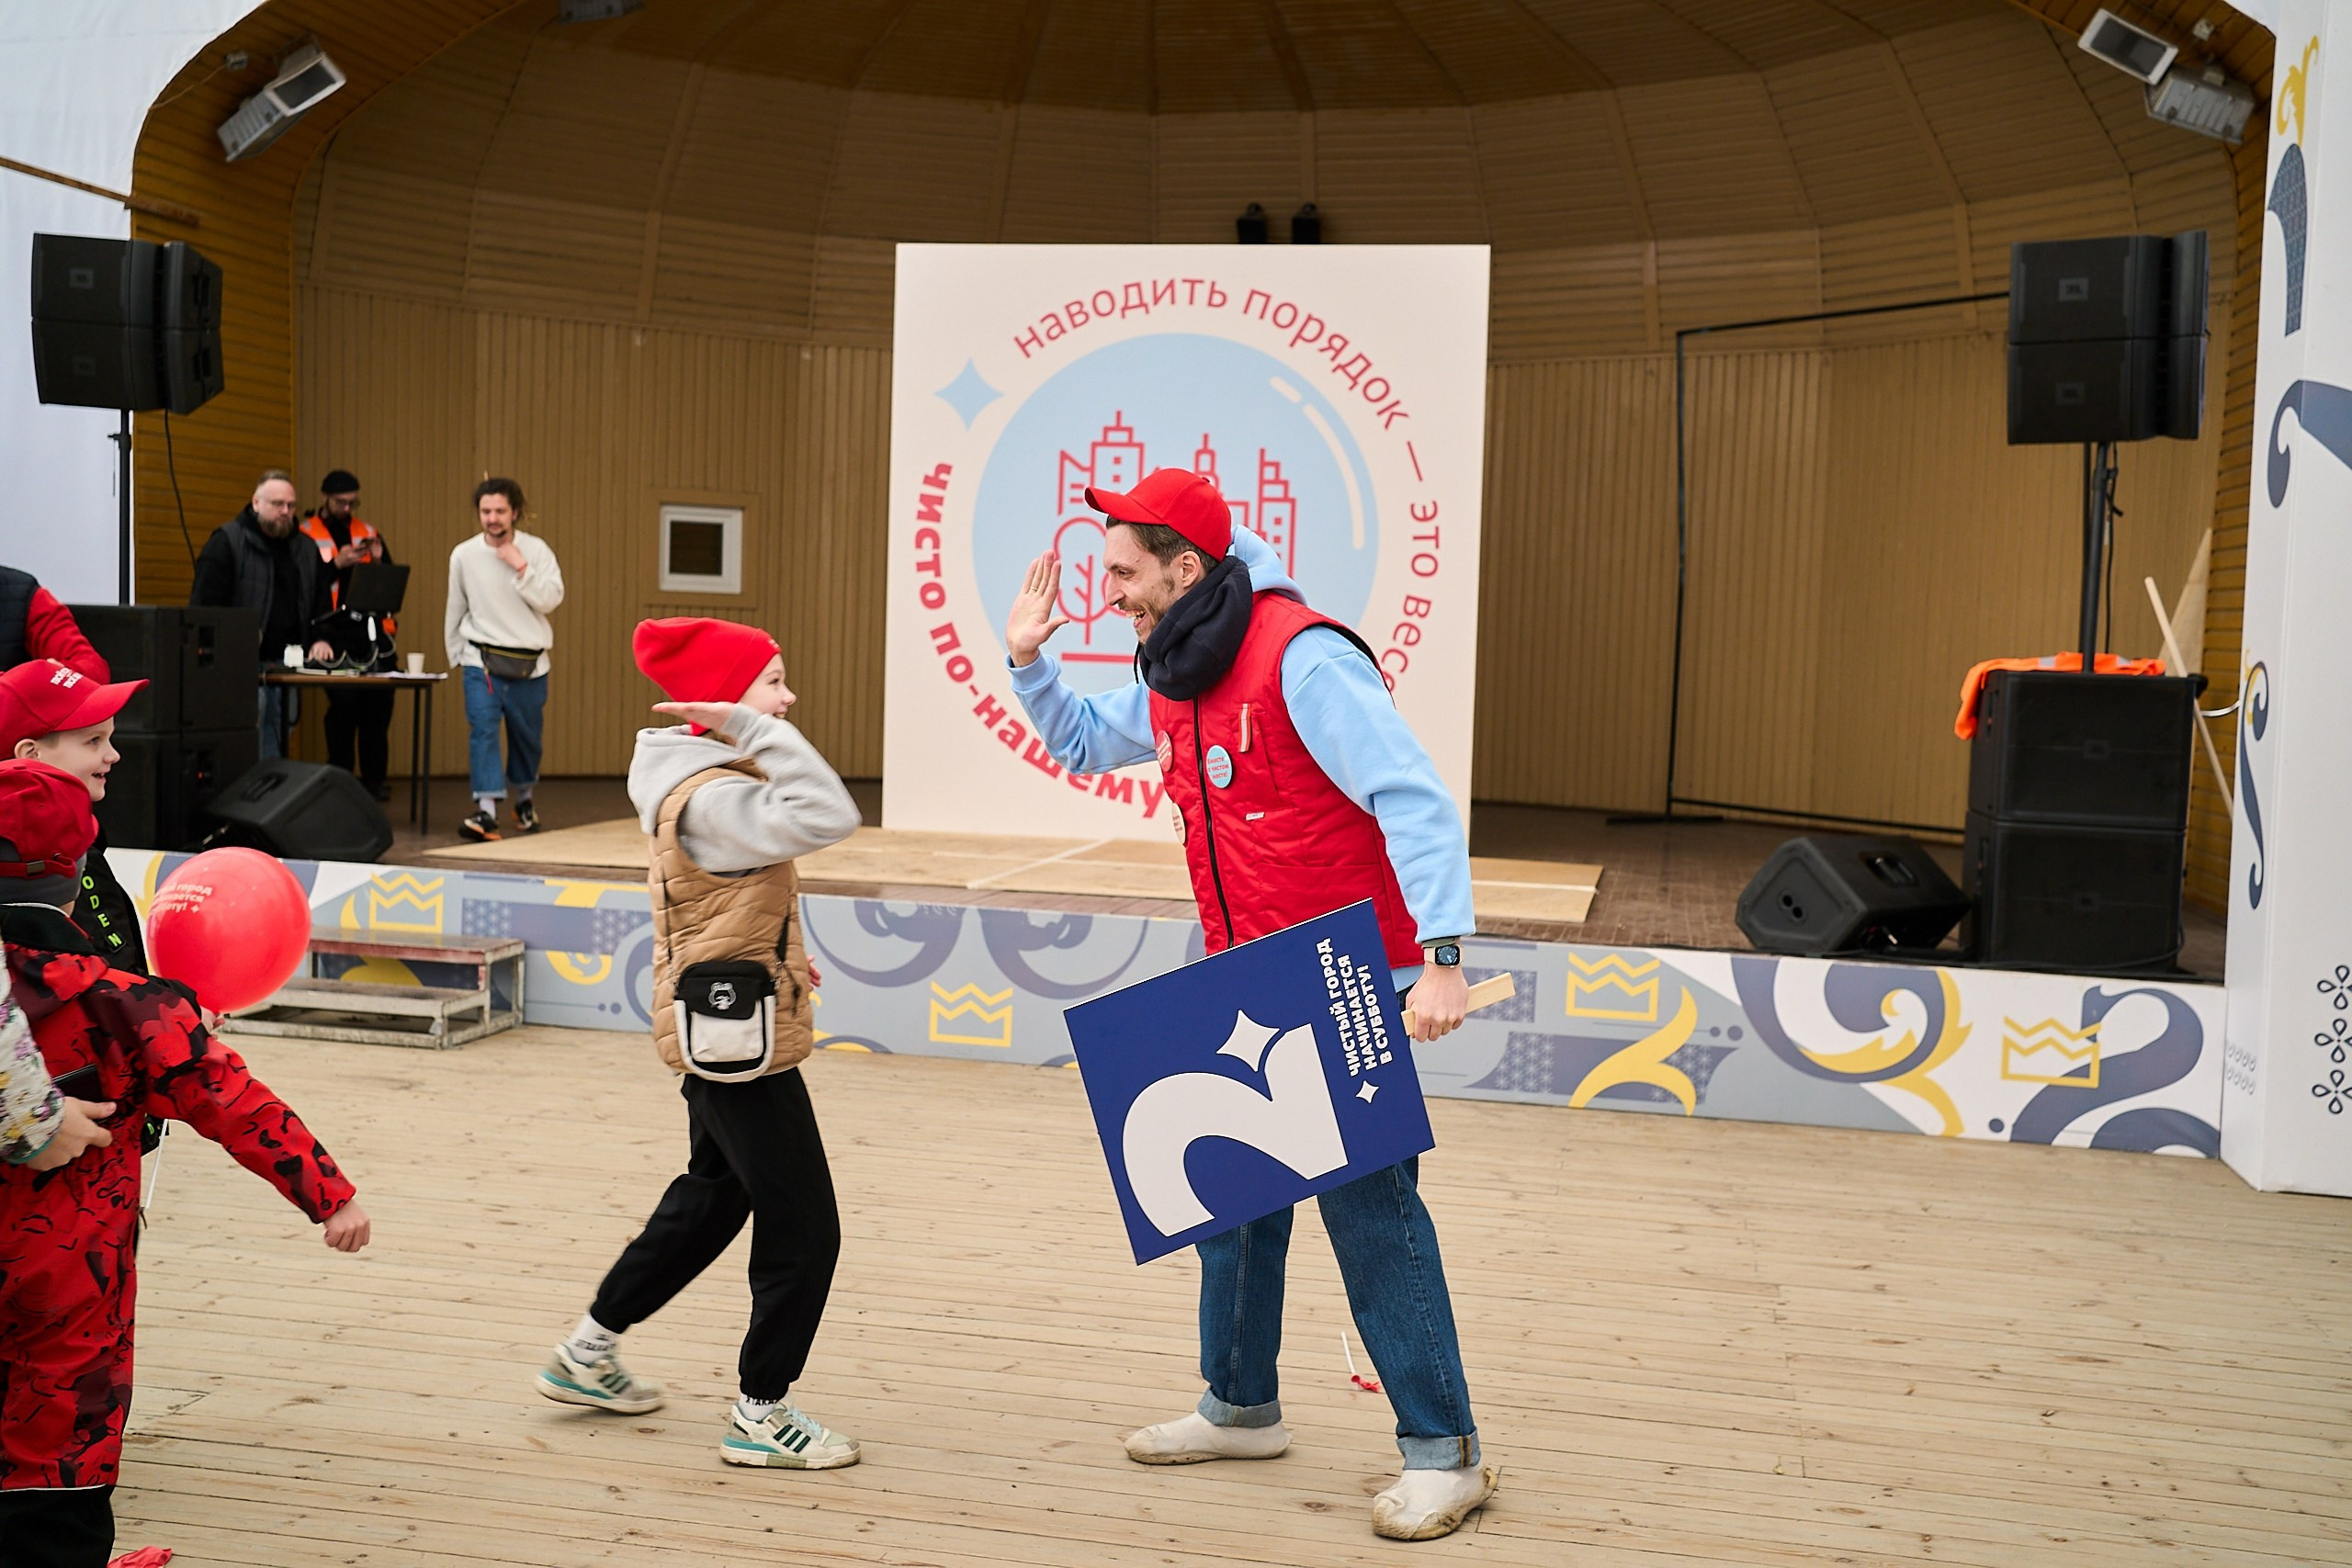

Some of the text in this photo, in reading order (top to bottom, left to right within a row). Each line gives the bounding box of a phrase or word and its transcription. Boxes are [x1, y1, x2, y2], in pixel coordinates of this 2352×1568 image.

[1013, 278, 1228, 358] наводить
[1242, 288, 1409, 431] порядок
[914, 462, 954, 610] чисто
[1410, 501, 1440, 577] это
[1381, 594, 1431, 693] весе
[82, 868, 122, 947] ODEN
[1316, 937, 1362, 1077] ЧИСТЫЙ ГОРОД
[1338, 954, 1378, 1070] НАЧИНАЕТСЯ
[1356, 964, 1393, 1064] В СУББОТУ!
